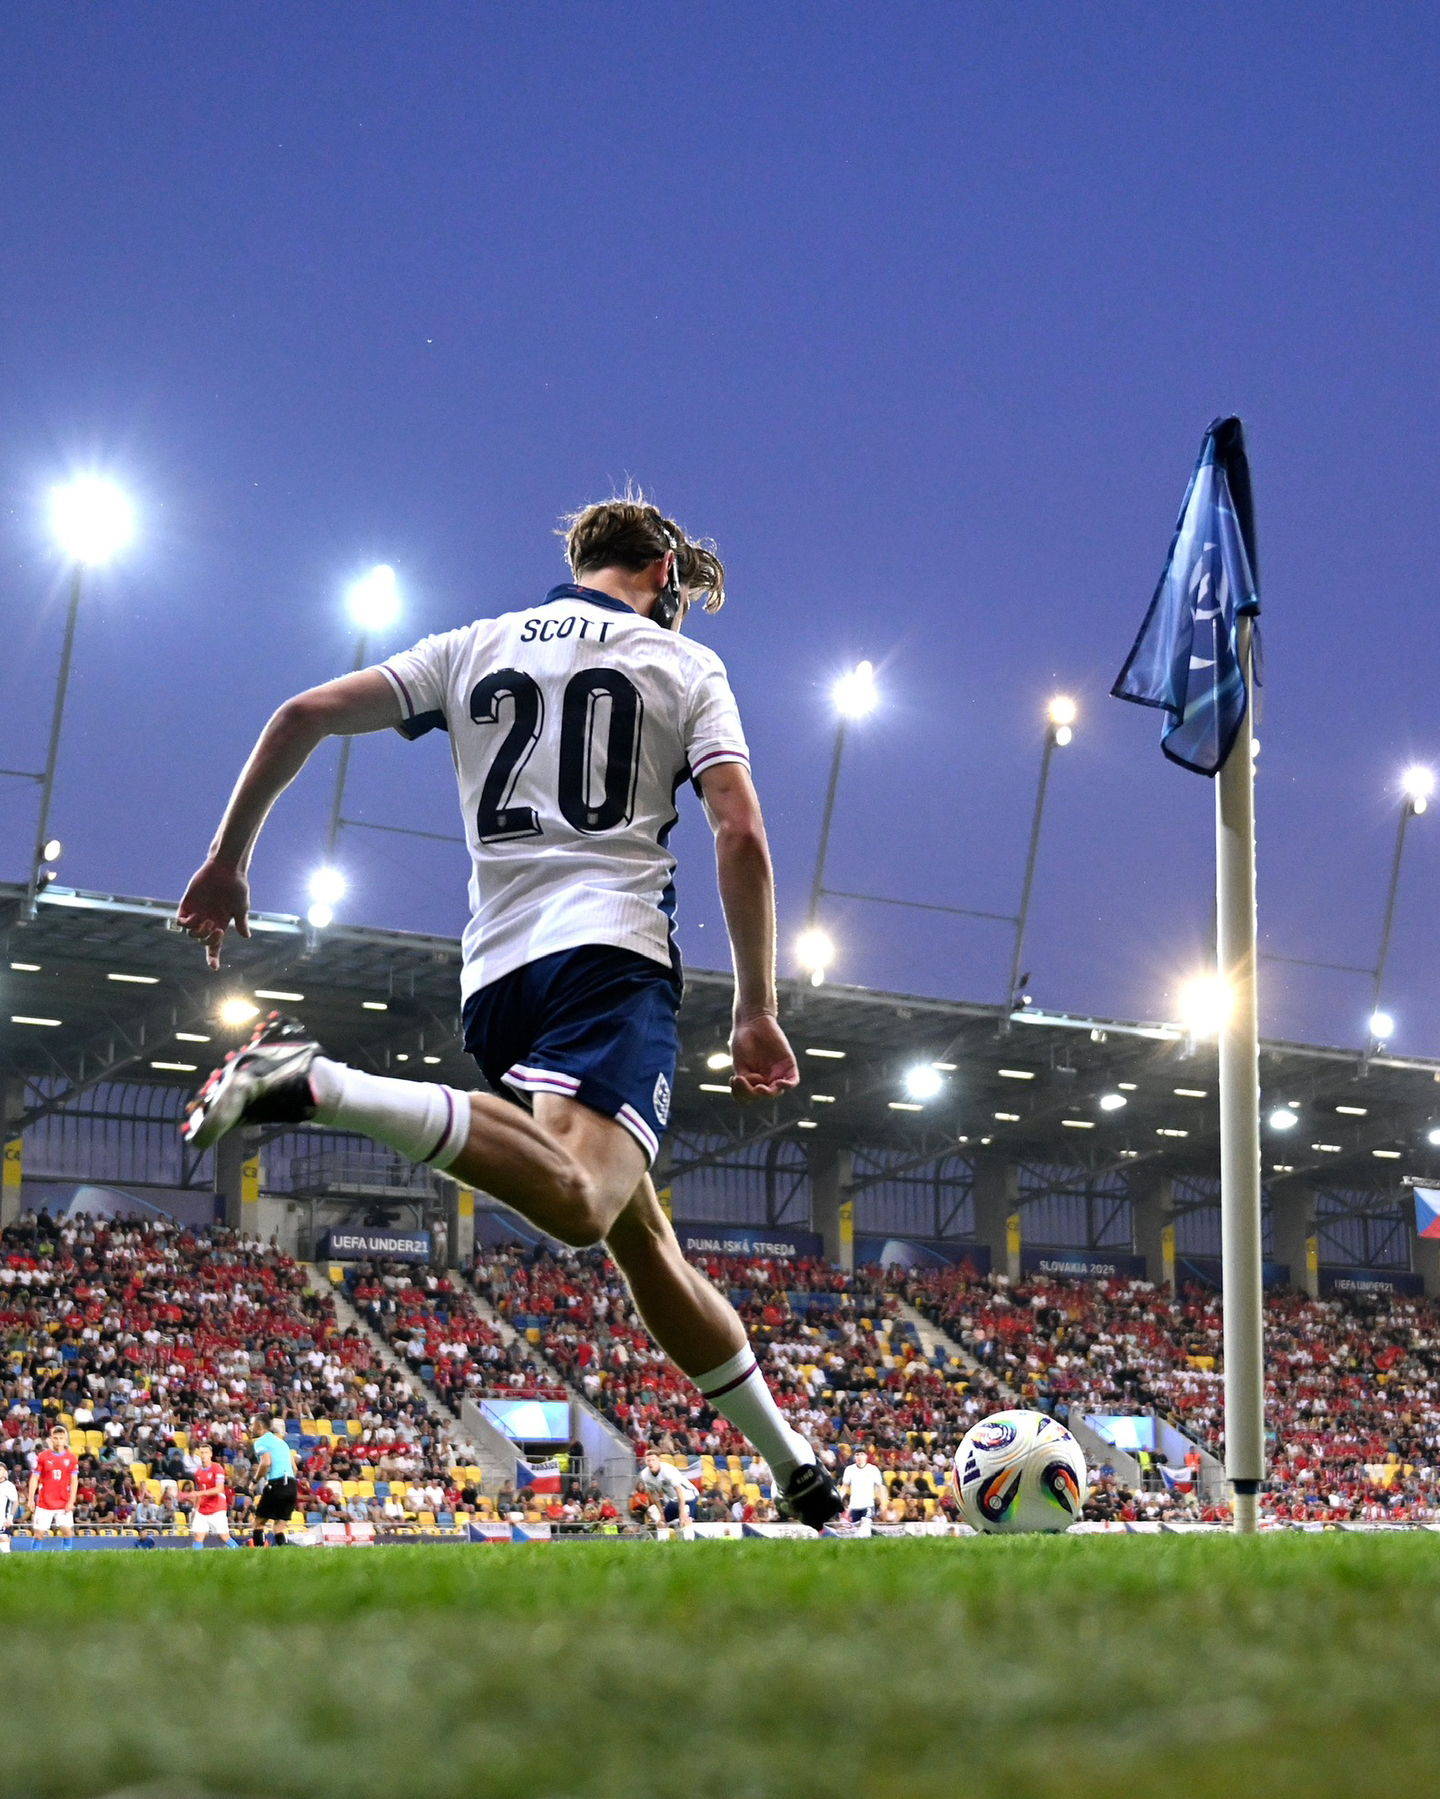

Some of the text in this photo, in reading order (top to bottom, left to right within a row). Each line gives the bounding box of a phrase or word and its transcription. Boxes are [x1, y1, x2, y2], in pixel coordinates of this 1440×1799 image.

[520, 616, 614, 643] SCOTT
[470, 667, 644, 844] 20
[333, 1235, 429, 1253] UEFA UNDER21
[687, 1238, 796, 1256] DUNAJSKÁ STREDA
[1040, 1260, 1087, 1274] SLOVAKIA
[1334, 1279, 1356, 1290] UEFA
[796, 1468, 815, 1485] KING
